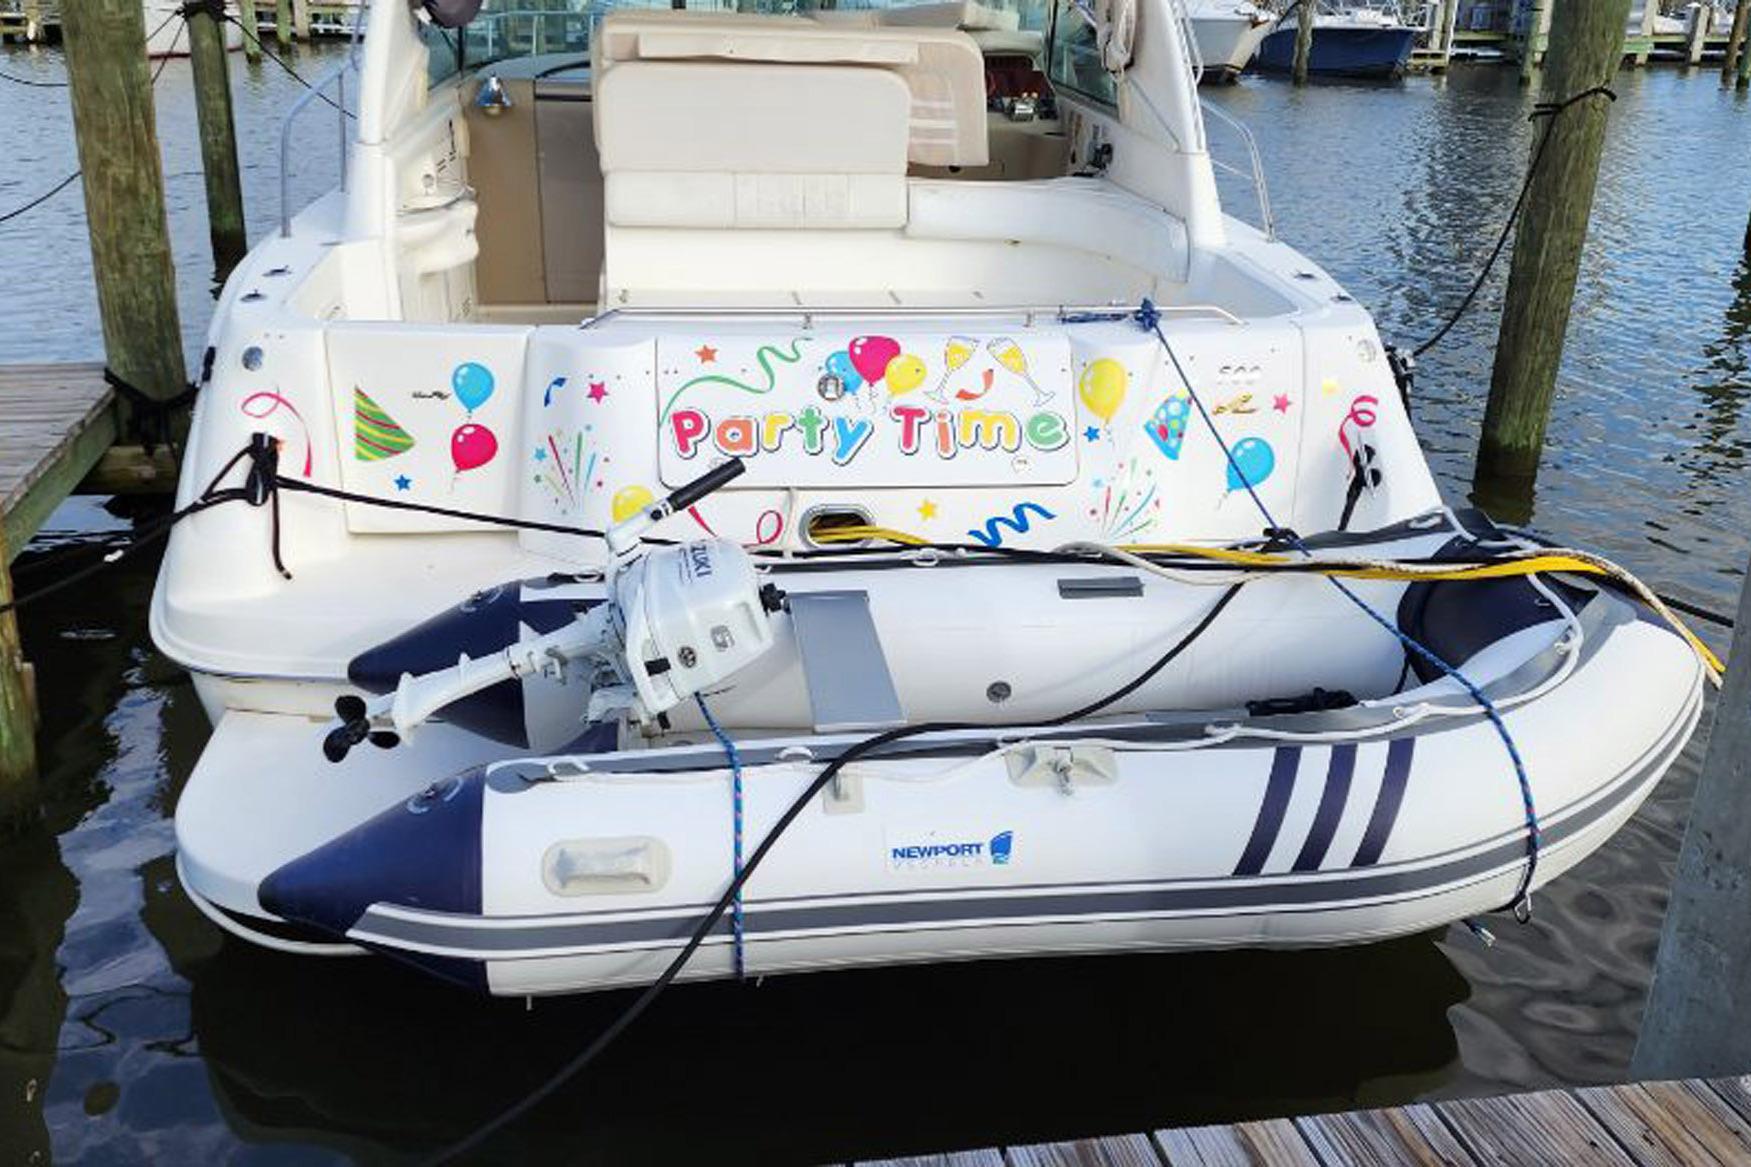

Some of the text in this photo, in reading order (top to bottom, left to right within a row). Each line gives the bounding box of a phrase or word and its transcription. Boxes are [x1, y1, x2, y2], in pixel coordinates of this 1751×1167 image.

[670, 407, 1070, 466] Party Time
[892, 843, 983, 858] NEWPORT
